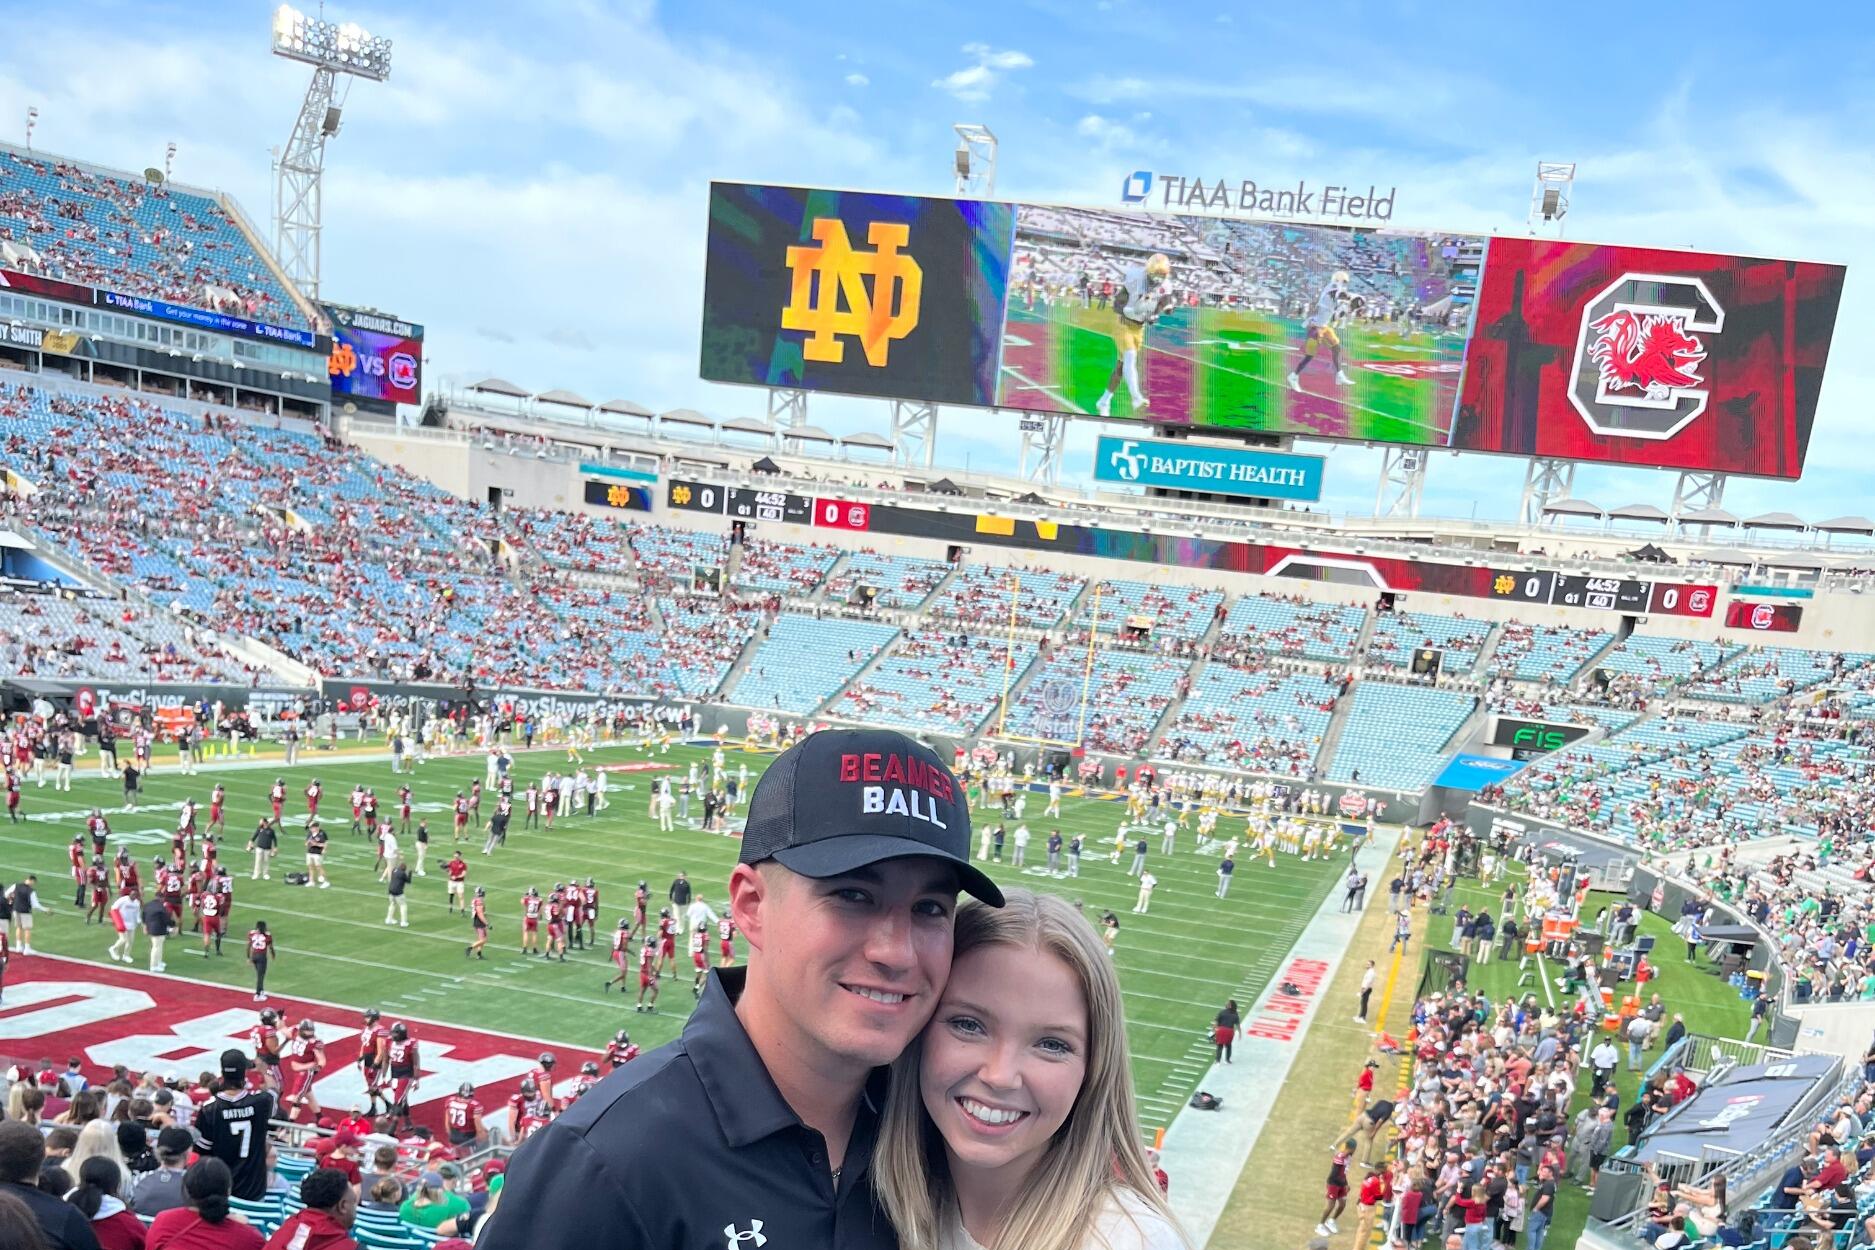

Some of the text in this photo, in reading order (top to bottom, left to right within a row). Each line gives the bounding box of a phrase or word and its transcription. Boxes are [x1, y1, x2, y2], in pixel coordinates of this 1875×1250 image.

[1159, 175, 1396, 220] TIAA Bank Field
[115, 294, 153, 312] TIAA Bank
[264, 325, 302, 342] TIAA Bank
[352, 313, 412, 337] JAGUARS.COM
[11, 326, 42, 346] SMITH
[359, 353, 385, 377] VS
[1150, 456, 1305, 488] BAPTIST HEALTH
[700, 488, 715, 507] 0
[825, 504, 839, 524] 0
[1524, 577, 1540, 598] 0
[1585, 578, 1621, 593] 44:52
[1663, 589, 1679, 609] 0
[840, 753, 957, 806] BEAMER
[863, 786, 948, 830] BALL
[222, 1106, 255, 1120] RATTLER
[449, 1108, 467, 1127] 73
[230, 1120, 252, 1158] 7
